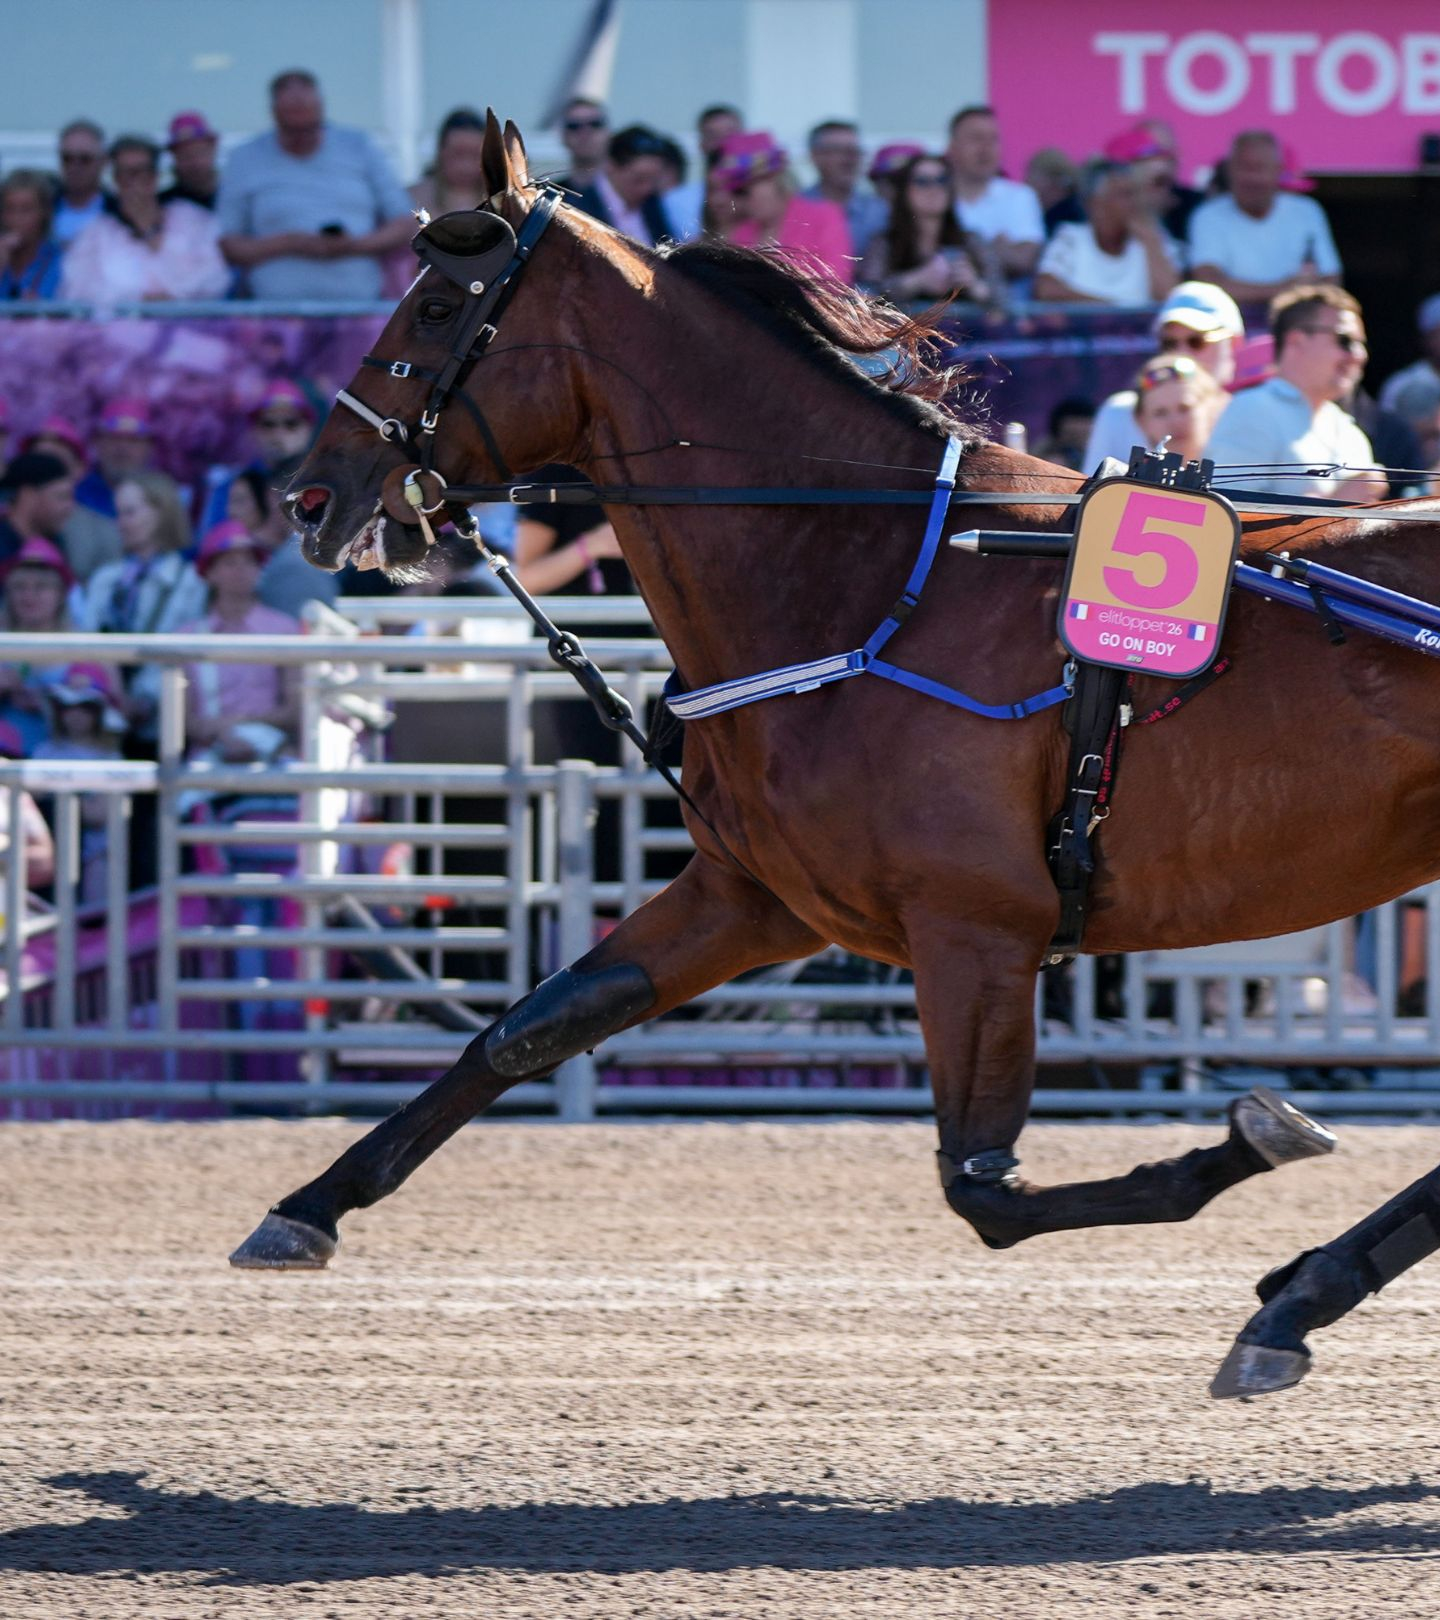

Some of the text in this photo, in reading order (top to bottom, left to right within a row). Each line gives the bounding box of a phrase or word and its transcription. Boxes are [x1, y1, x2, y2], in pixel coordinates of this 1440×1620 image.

[1102, 491, 1207, 610] 5
[1099, 632, 1176, 657] GO ON BOY
